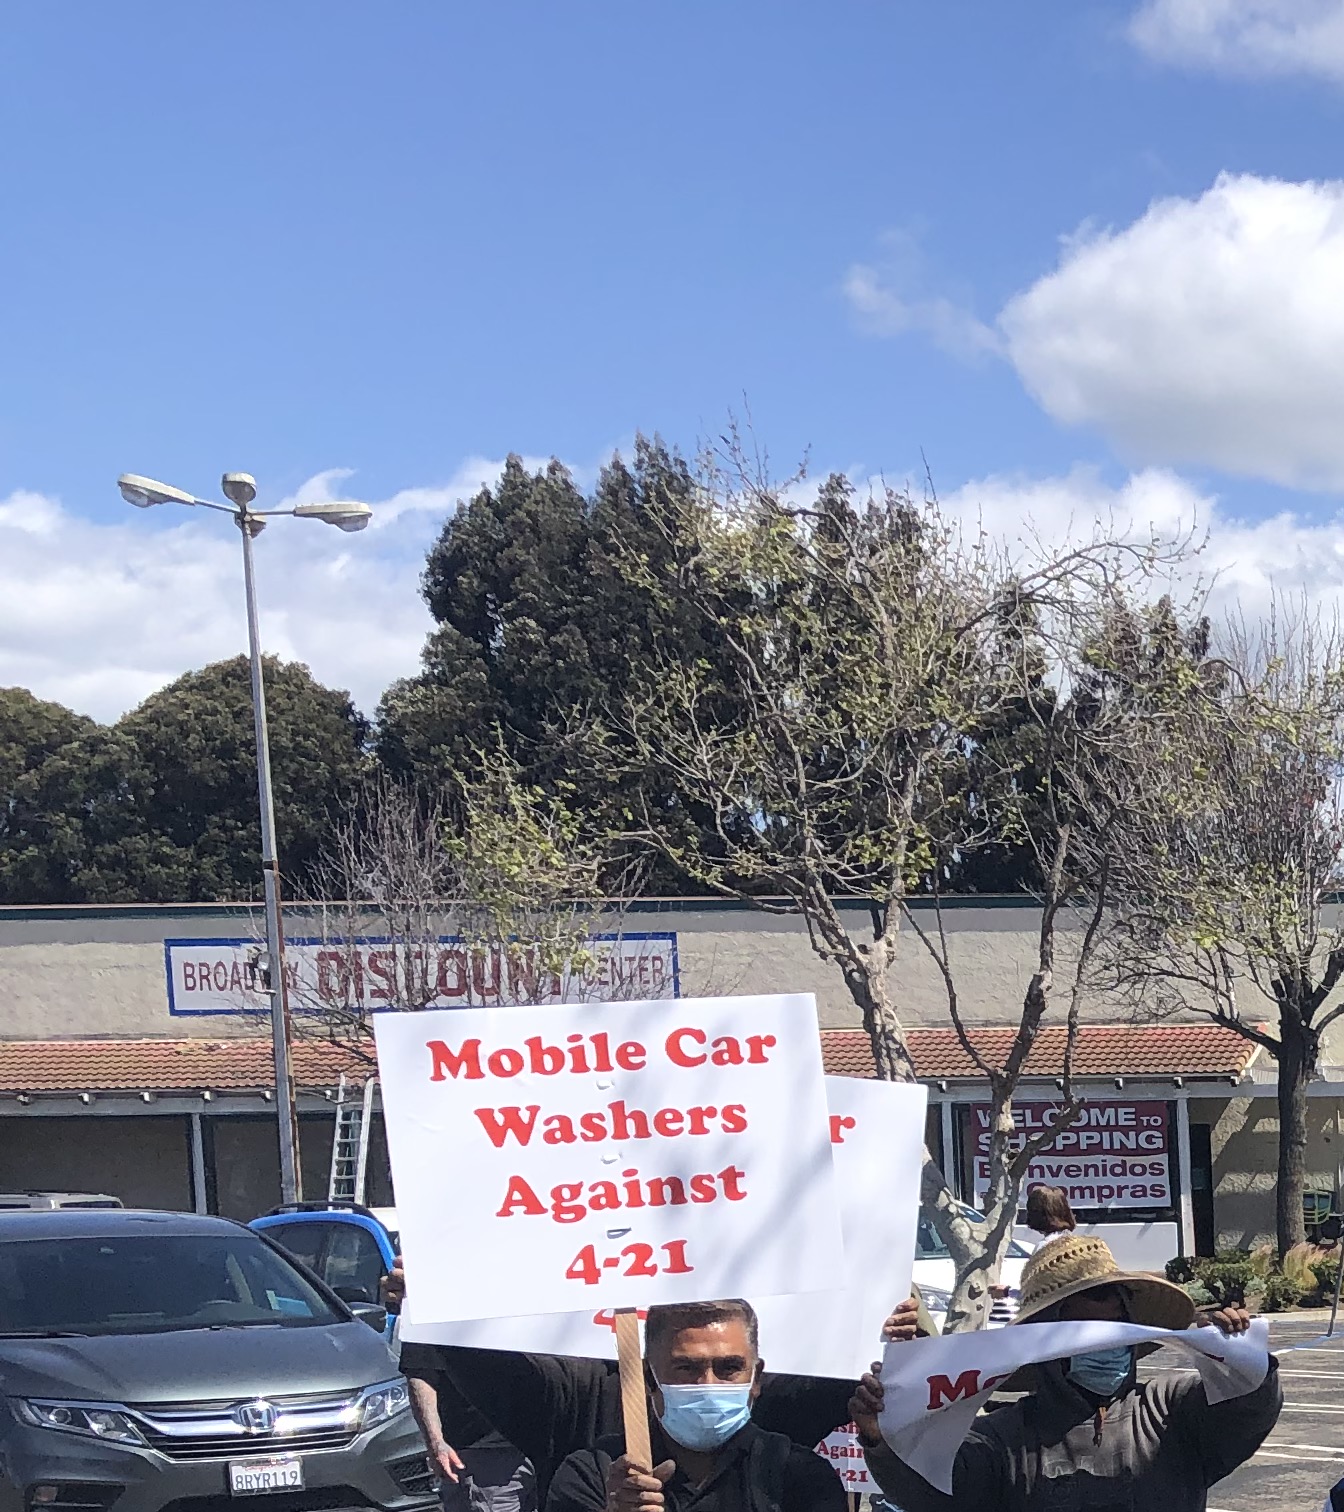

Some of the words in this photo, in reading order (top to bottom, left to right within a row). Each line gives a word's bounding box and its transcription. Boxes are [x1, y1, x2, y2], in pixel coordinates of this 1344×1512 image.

[183, 960, 299, 991] BROADY
[426, 1031, 646, 1082] Mobile
[665, 1027, 777, 1068] Car
[474, 1100, 748, 1148] Washers
[1140, 1116, 1163, 1127] TO
[978, 1129, 1164, 1152] SHPPING
[979, 1158, 1166, 1179] Bnvenidos
[496, 1165, 748, 1224] Against
[565, 1239, 695, 1285] 4-21
[235, 1470, 299, 1490] 8RYR119
